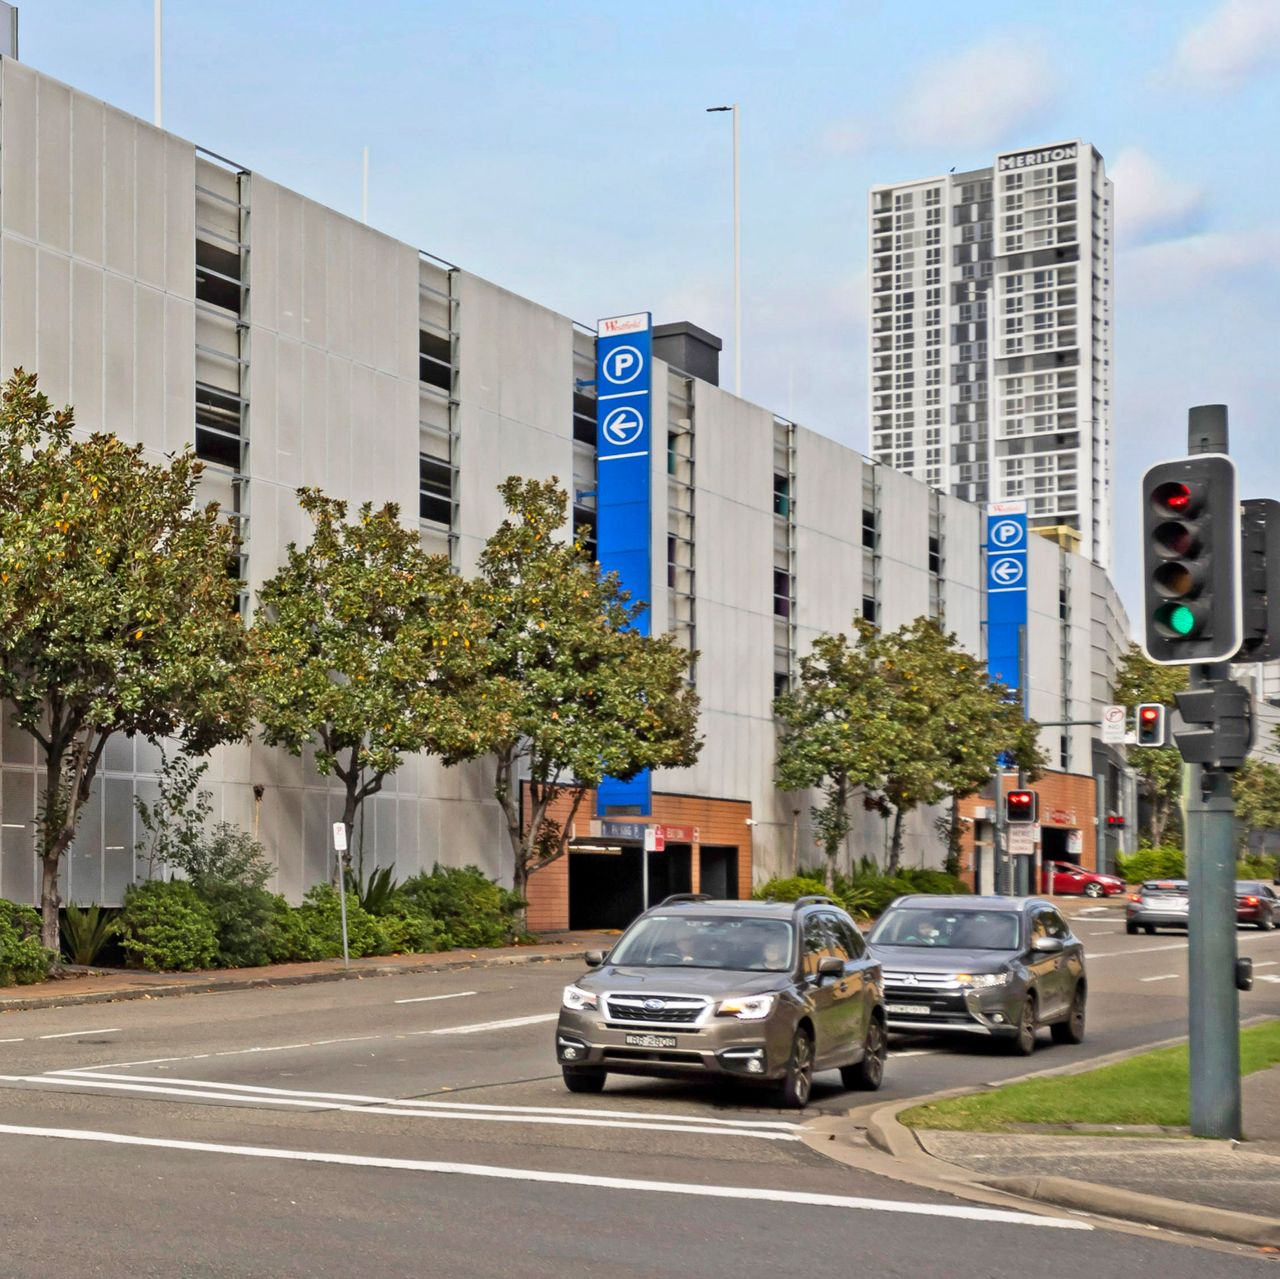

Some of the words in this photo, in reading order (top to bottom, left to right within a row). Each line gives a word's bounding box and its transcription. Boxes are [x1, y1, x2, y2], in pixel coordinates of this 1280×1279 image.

[1000, 145, 1077, 170] MERITON
[615, 353, 634, 377] P
[1001, 525, 1016, 542] P
